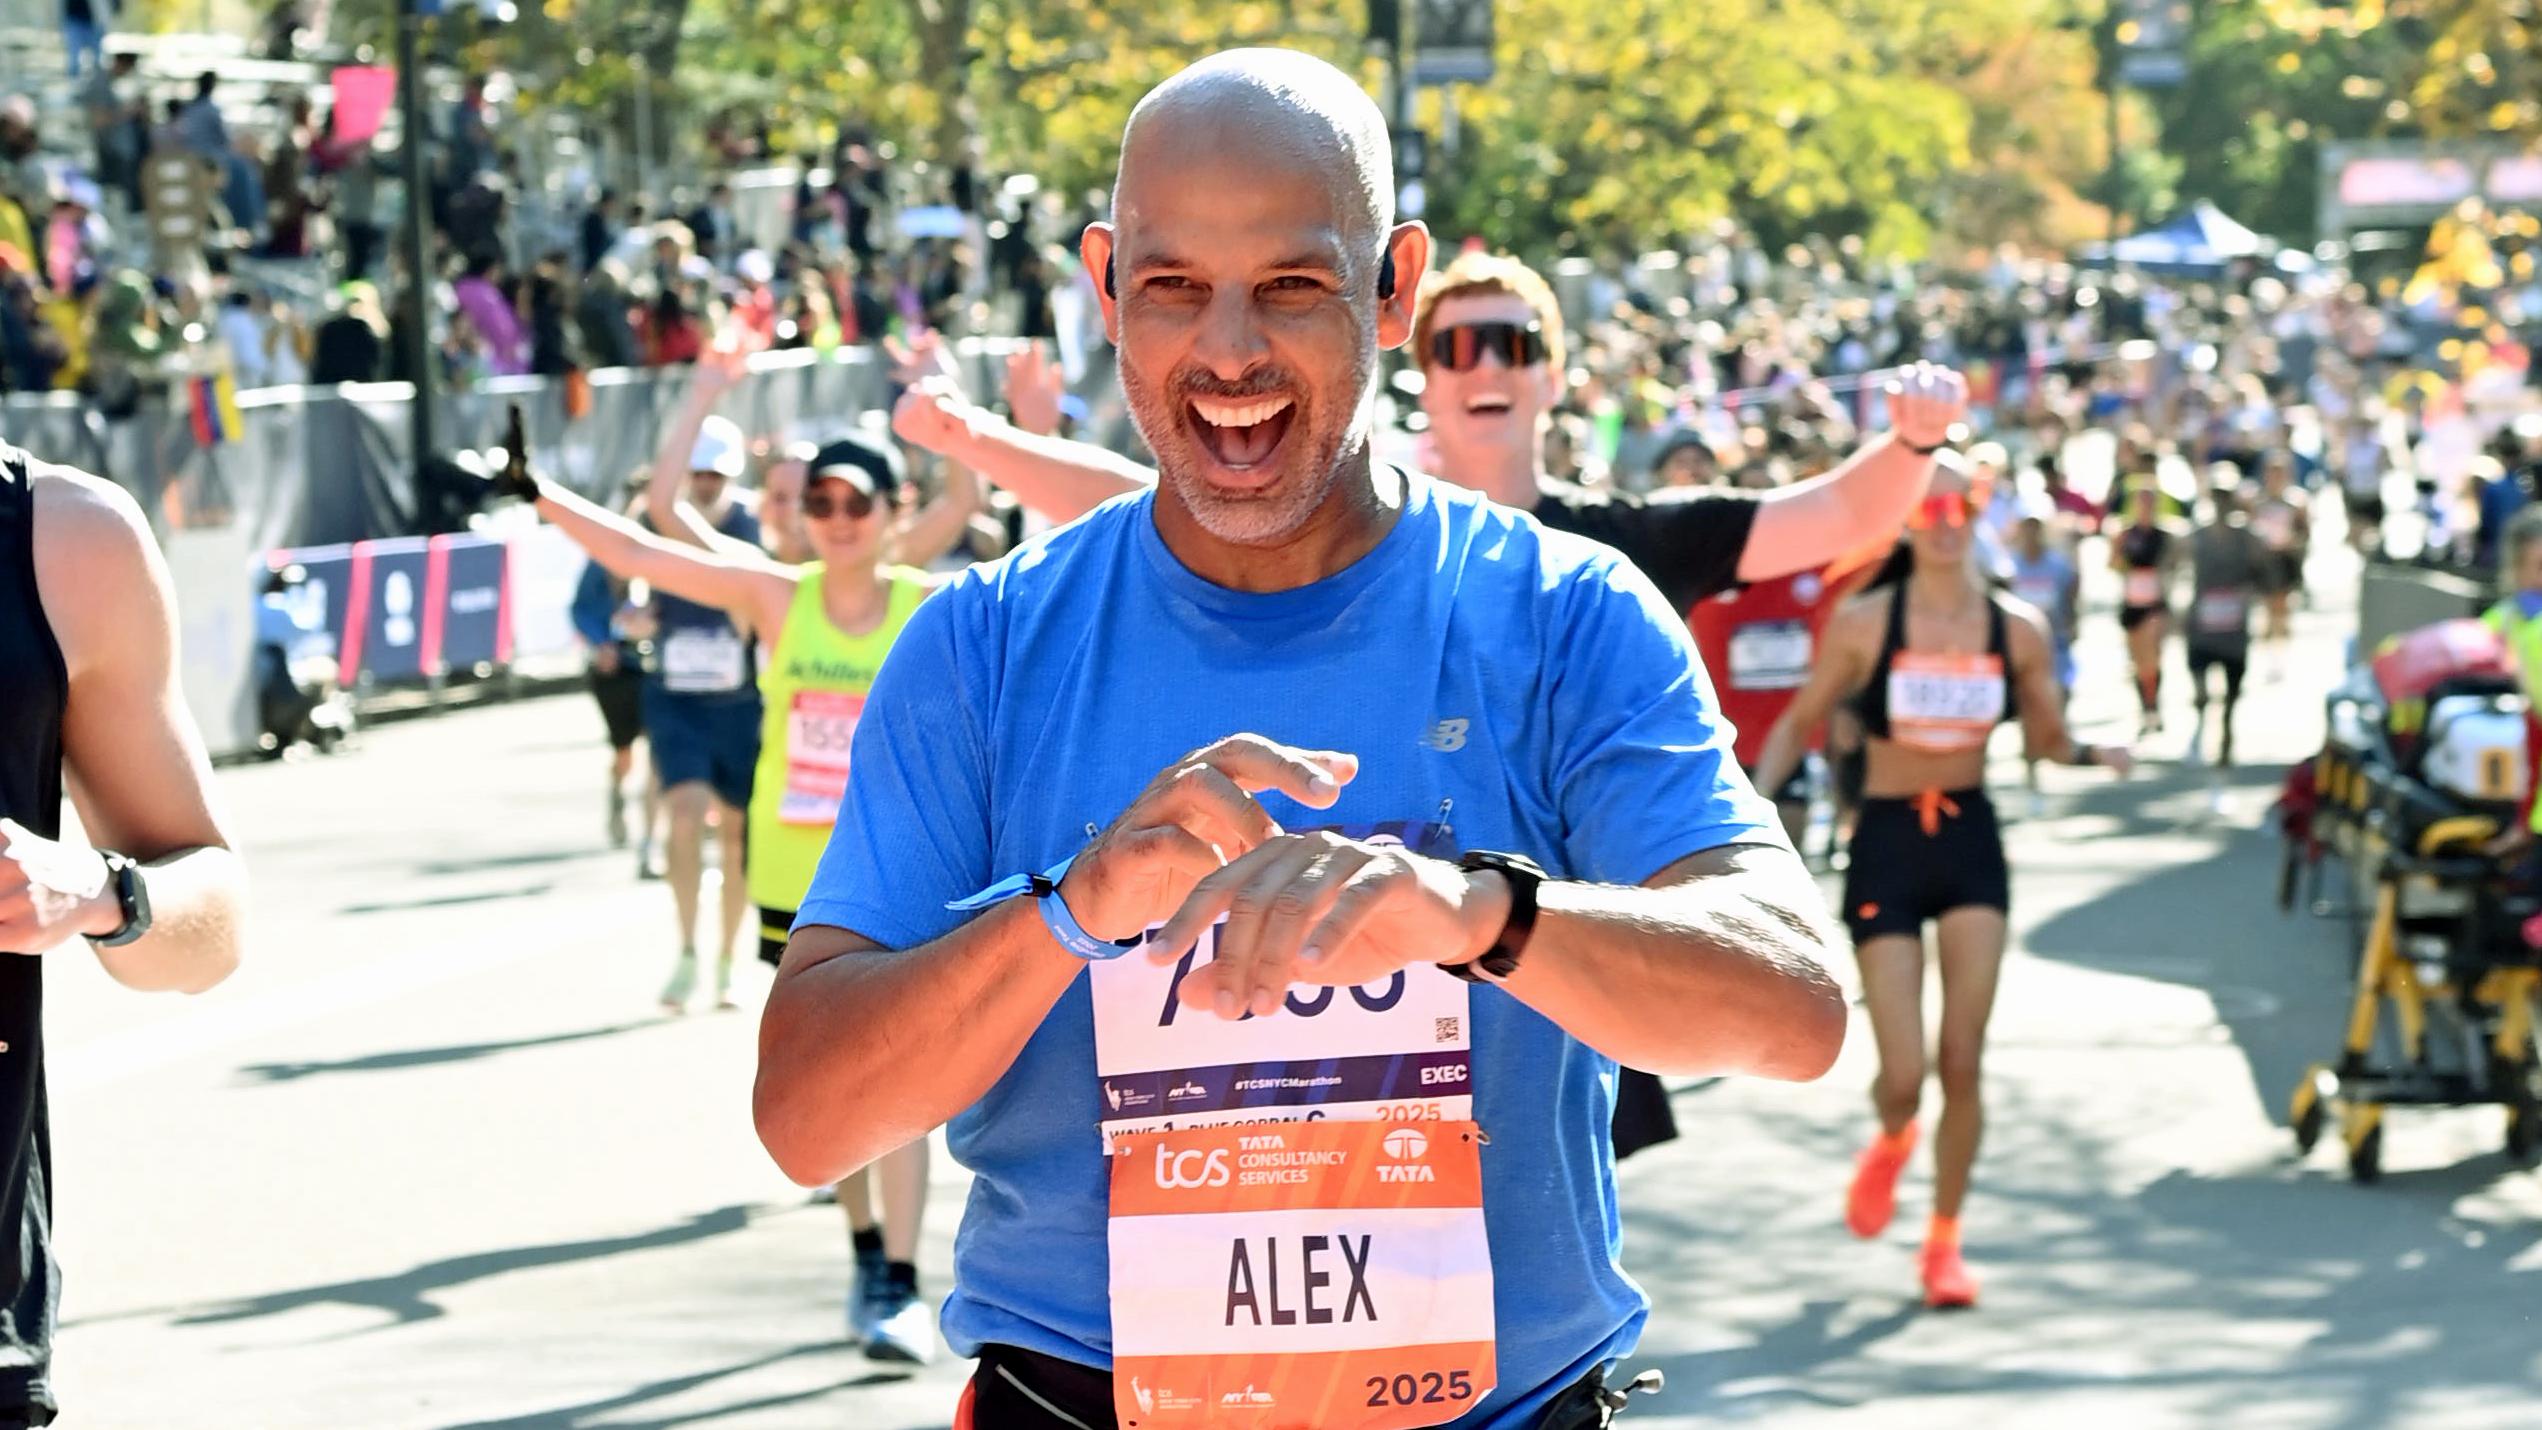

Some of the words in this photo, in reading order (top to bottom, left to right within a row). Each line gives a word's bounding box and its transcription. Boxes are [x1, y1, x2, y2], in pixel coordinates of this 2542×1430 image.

[1420, 1064, 1468, 1085] EXEC
[1234, 1076, 1342, 1091] #TCSNYCMarathon
[1238, 1135, 1285, 1150] TATA
[1238, 1151, 1347, 1168] CONSULTANCY
[1238, 1169, 1308, 1187] SERVICES
[1376, 1165, 1435, 1182] TATA
[1225, 1234, 1378, 1326] ALEX
[1366, 1370, 1472, 1407] 2025
